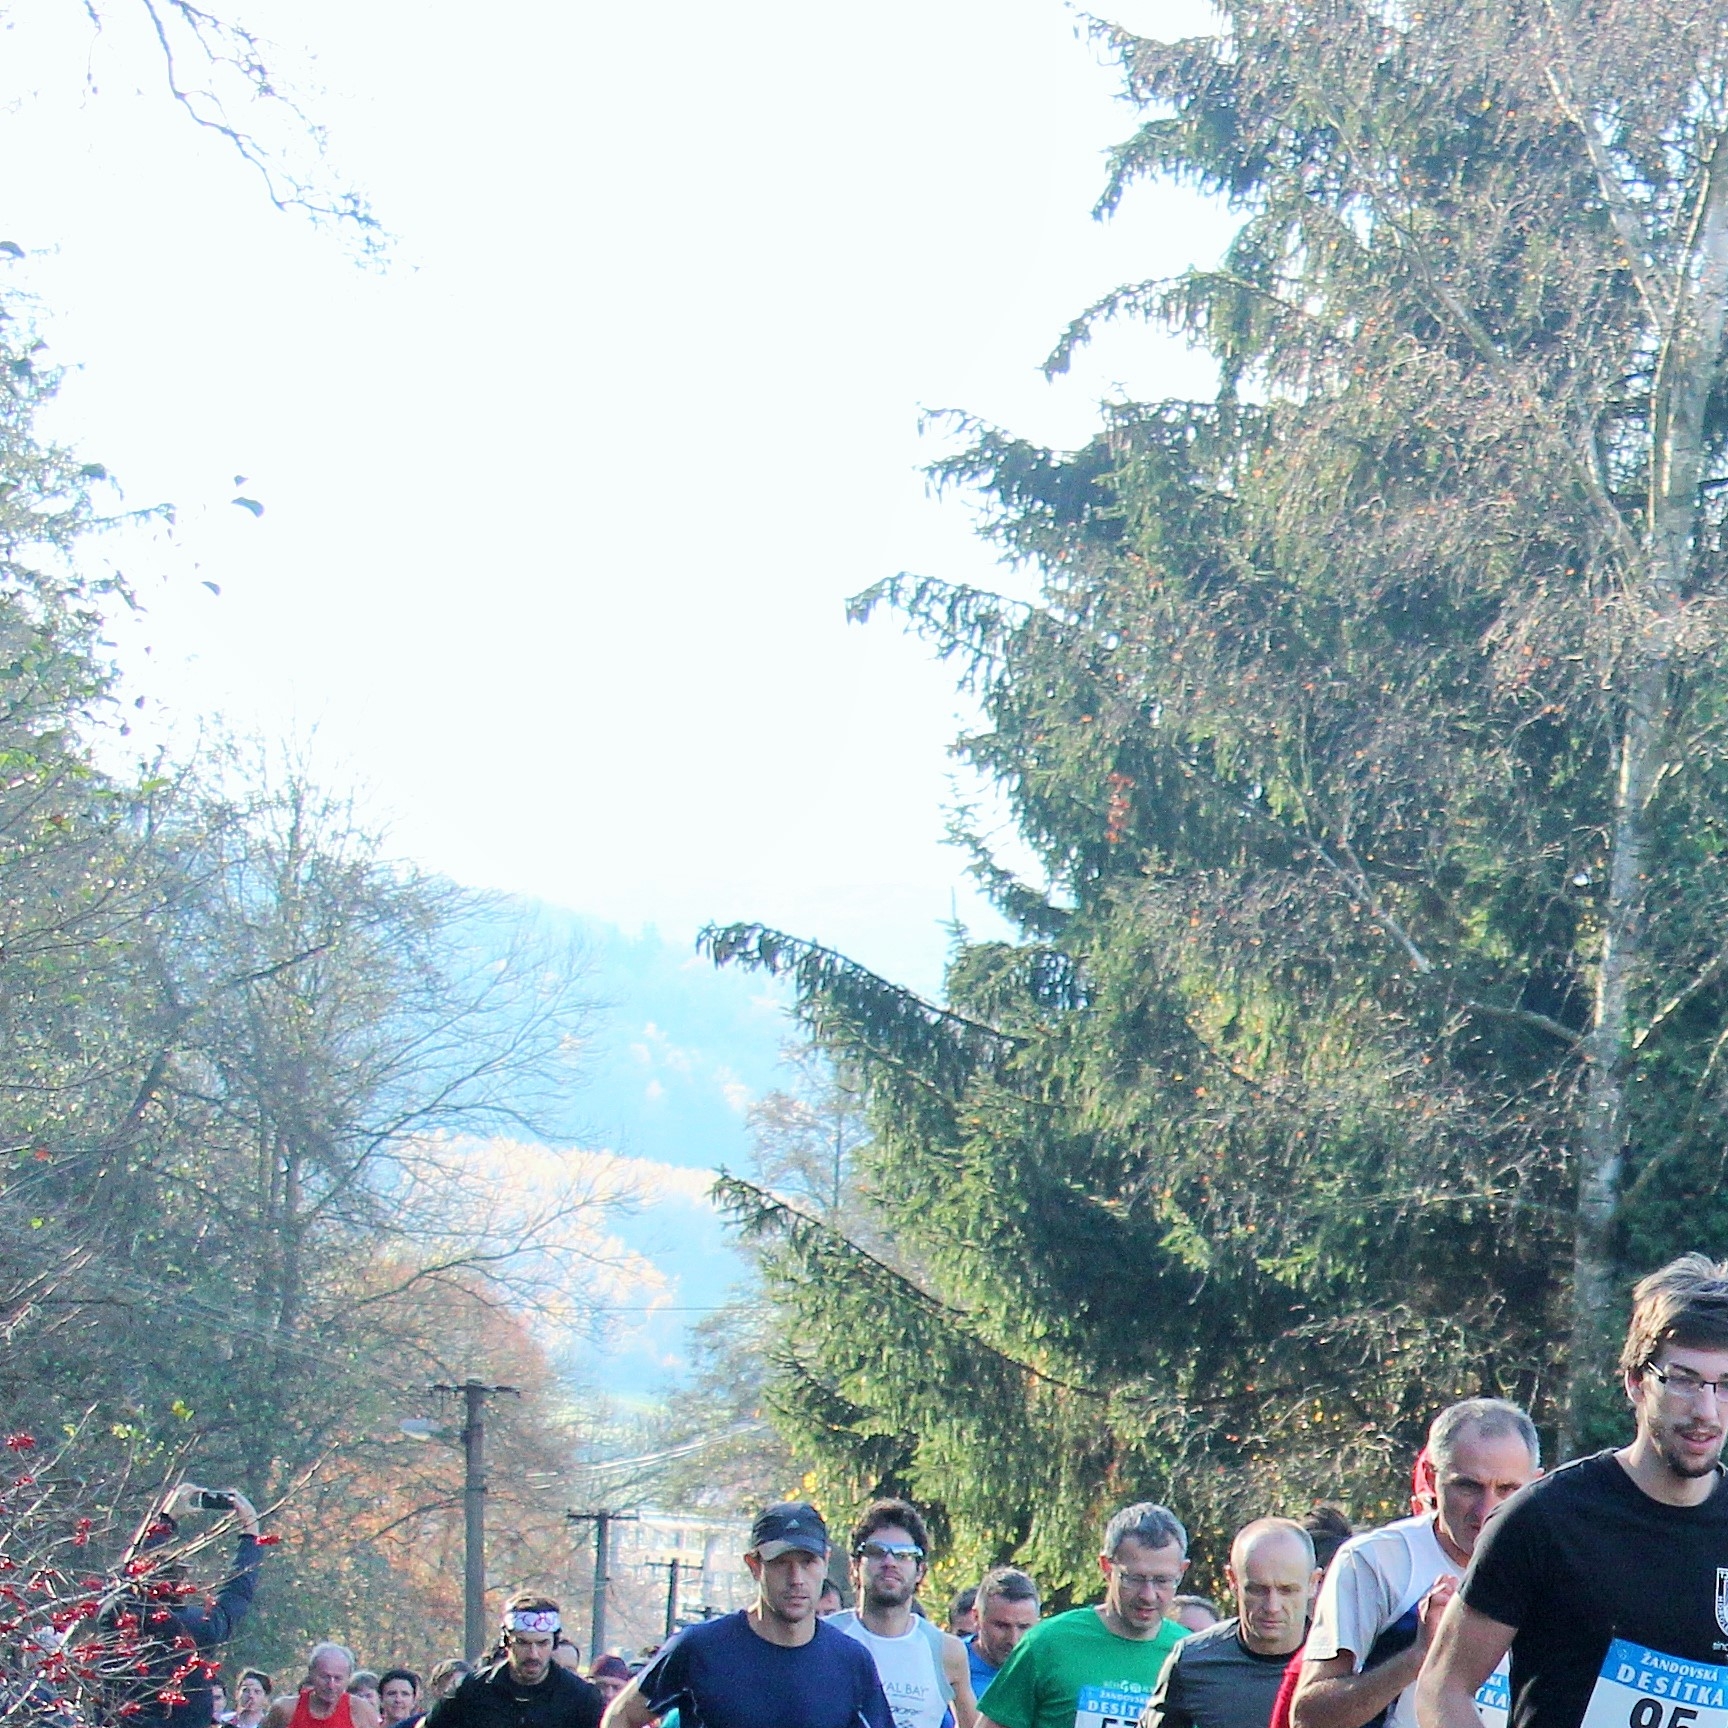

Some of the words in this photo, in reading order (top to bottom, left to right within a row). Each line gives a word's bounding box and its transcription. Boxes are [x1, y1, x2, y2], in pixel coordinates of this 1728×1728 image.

[1640, 1653, 1718, 1682] ŽANDOVSKÁ
[1616, 1664, 1725, 1707] DESÍTKA
[1087, 1699, 1143, 1719] DESÍT
